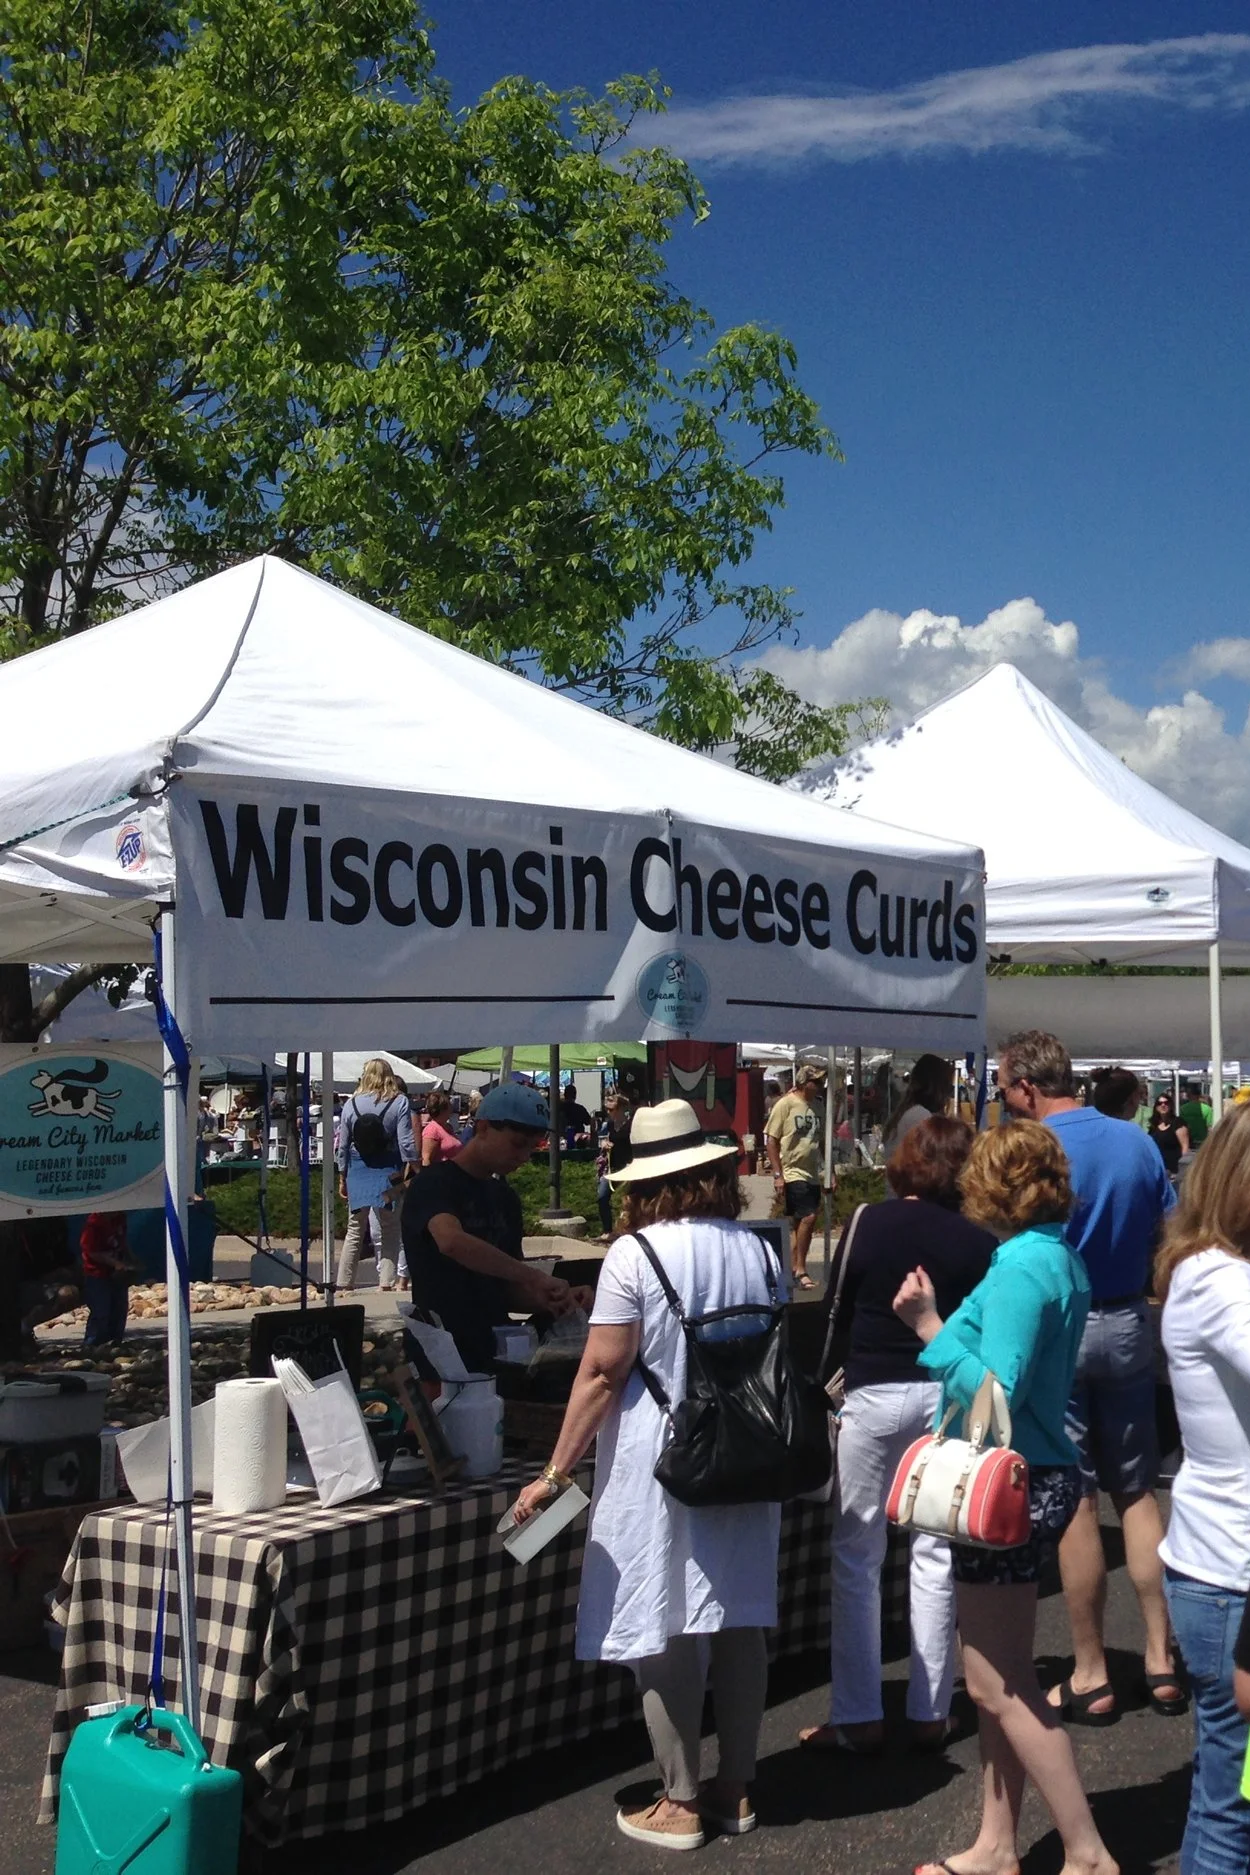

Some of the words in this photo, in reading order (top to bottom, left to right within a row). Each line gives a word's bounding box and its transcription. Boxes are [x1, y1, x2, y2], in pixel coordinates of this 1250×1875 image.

[198, 800, 608, 931] Wisconsin
[630, 837, 830, 950] Cheese
[846, 869, 977, 963] Curds
[0, 1133, 42, 1149] ream
[47, 1125, 88, 1155] City
[93, 1120, 161, 1144] Market
[16, 1156, 73, 1172] LEGENDARY
[76, 1154, 127, 1168] WISCONSIN
[36, 1169, 72, 1183] CHEESE
[76, 1168, 106, 1181] CURDS
